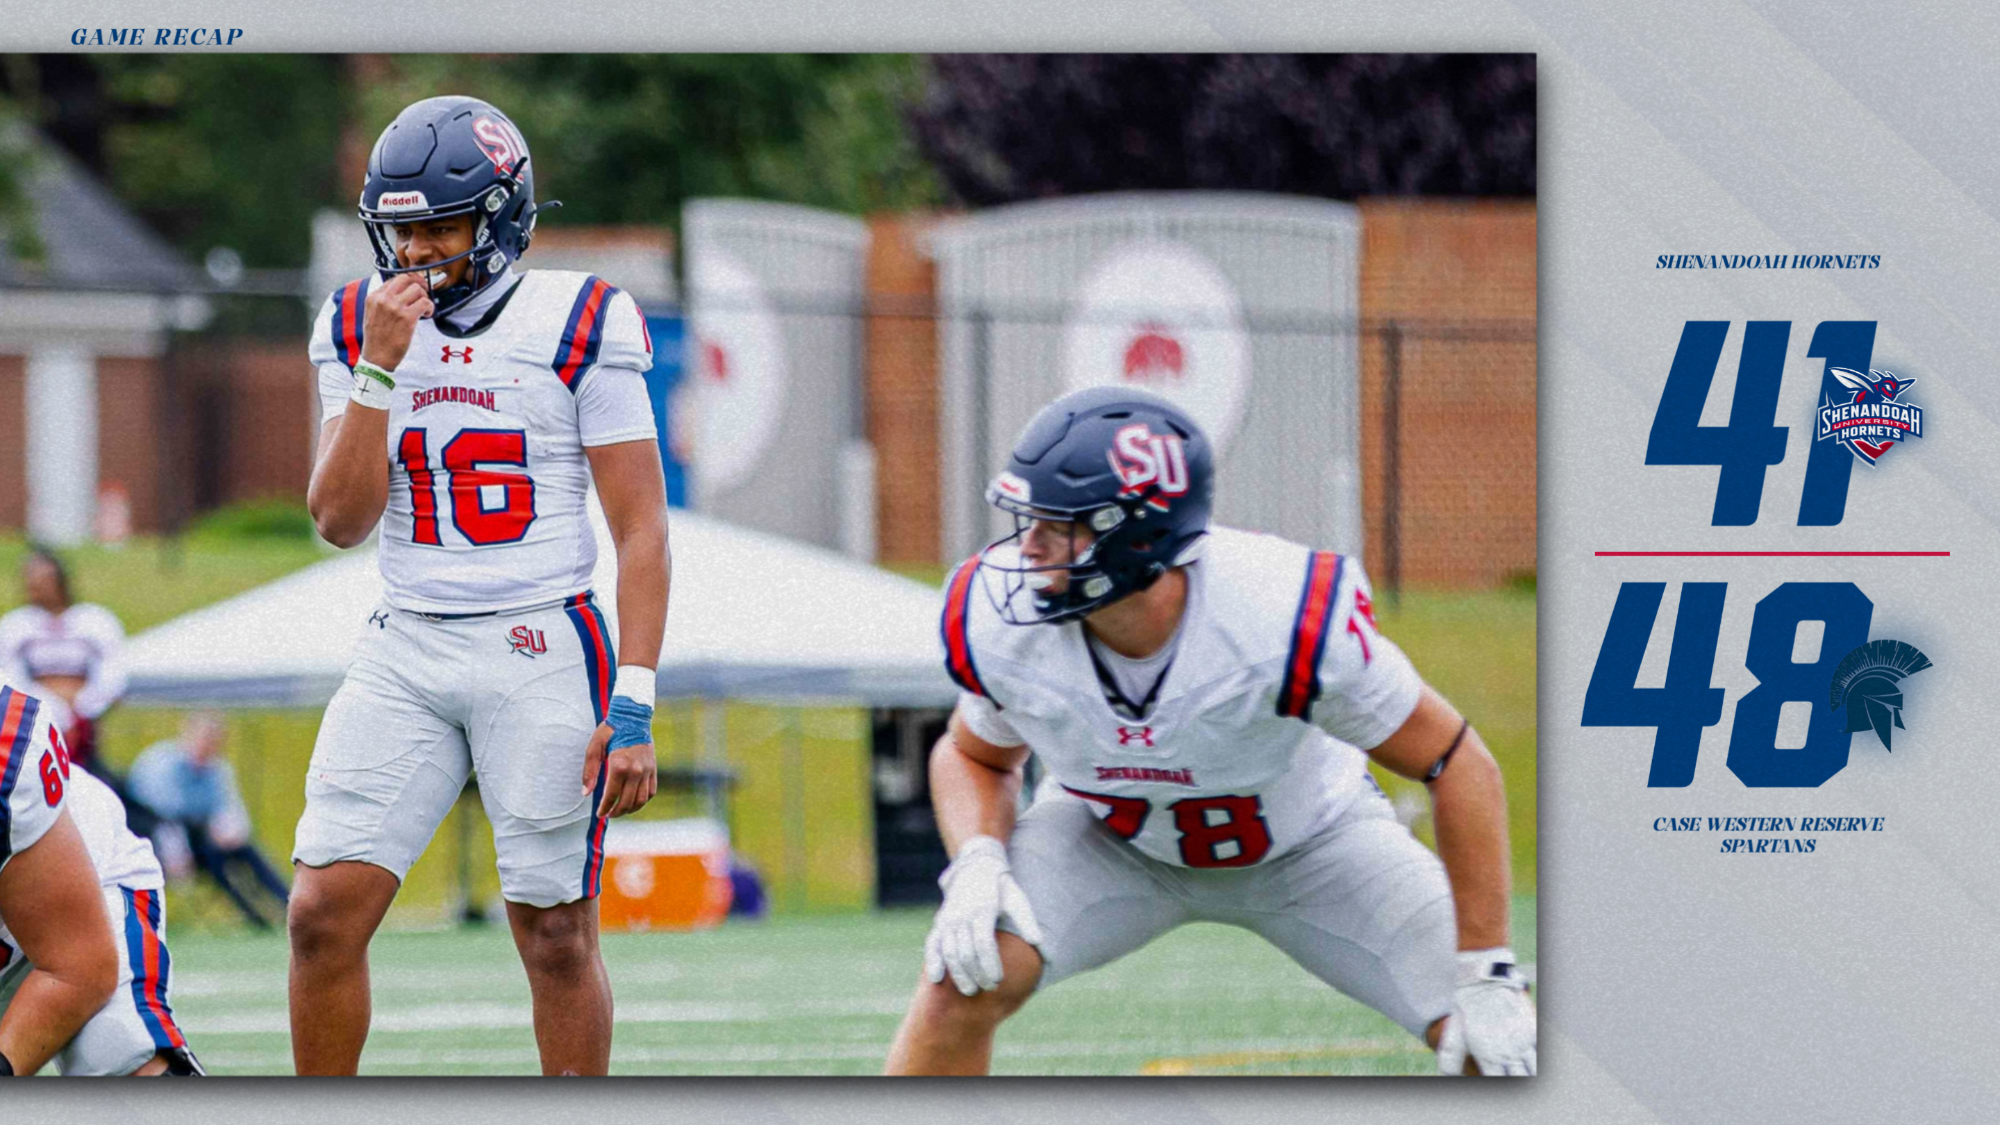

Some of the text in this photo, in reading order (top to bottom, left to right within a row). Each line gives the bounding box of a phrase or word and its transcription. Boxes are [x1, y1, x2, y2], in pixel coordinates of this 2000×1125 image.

[382, 195, 419, 206] Riddell
[411, 386, 498, 412] SHENANDOAH
[397, 427, 538, 547] 16
[1111, 423, 1189, 498] SU
[508, 625, 547, 655] SU
[38, 722, 70, 808] 66
[1059, 783, 1274, 869] 78
